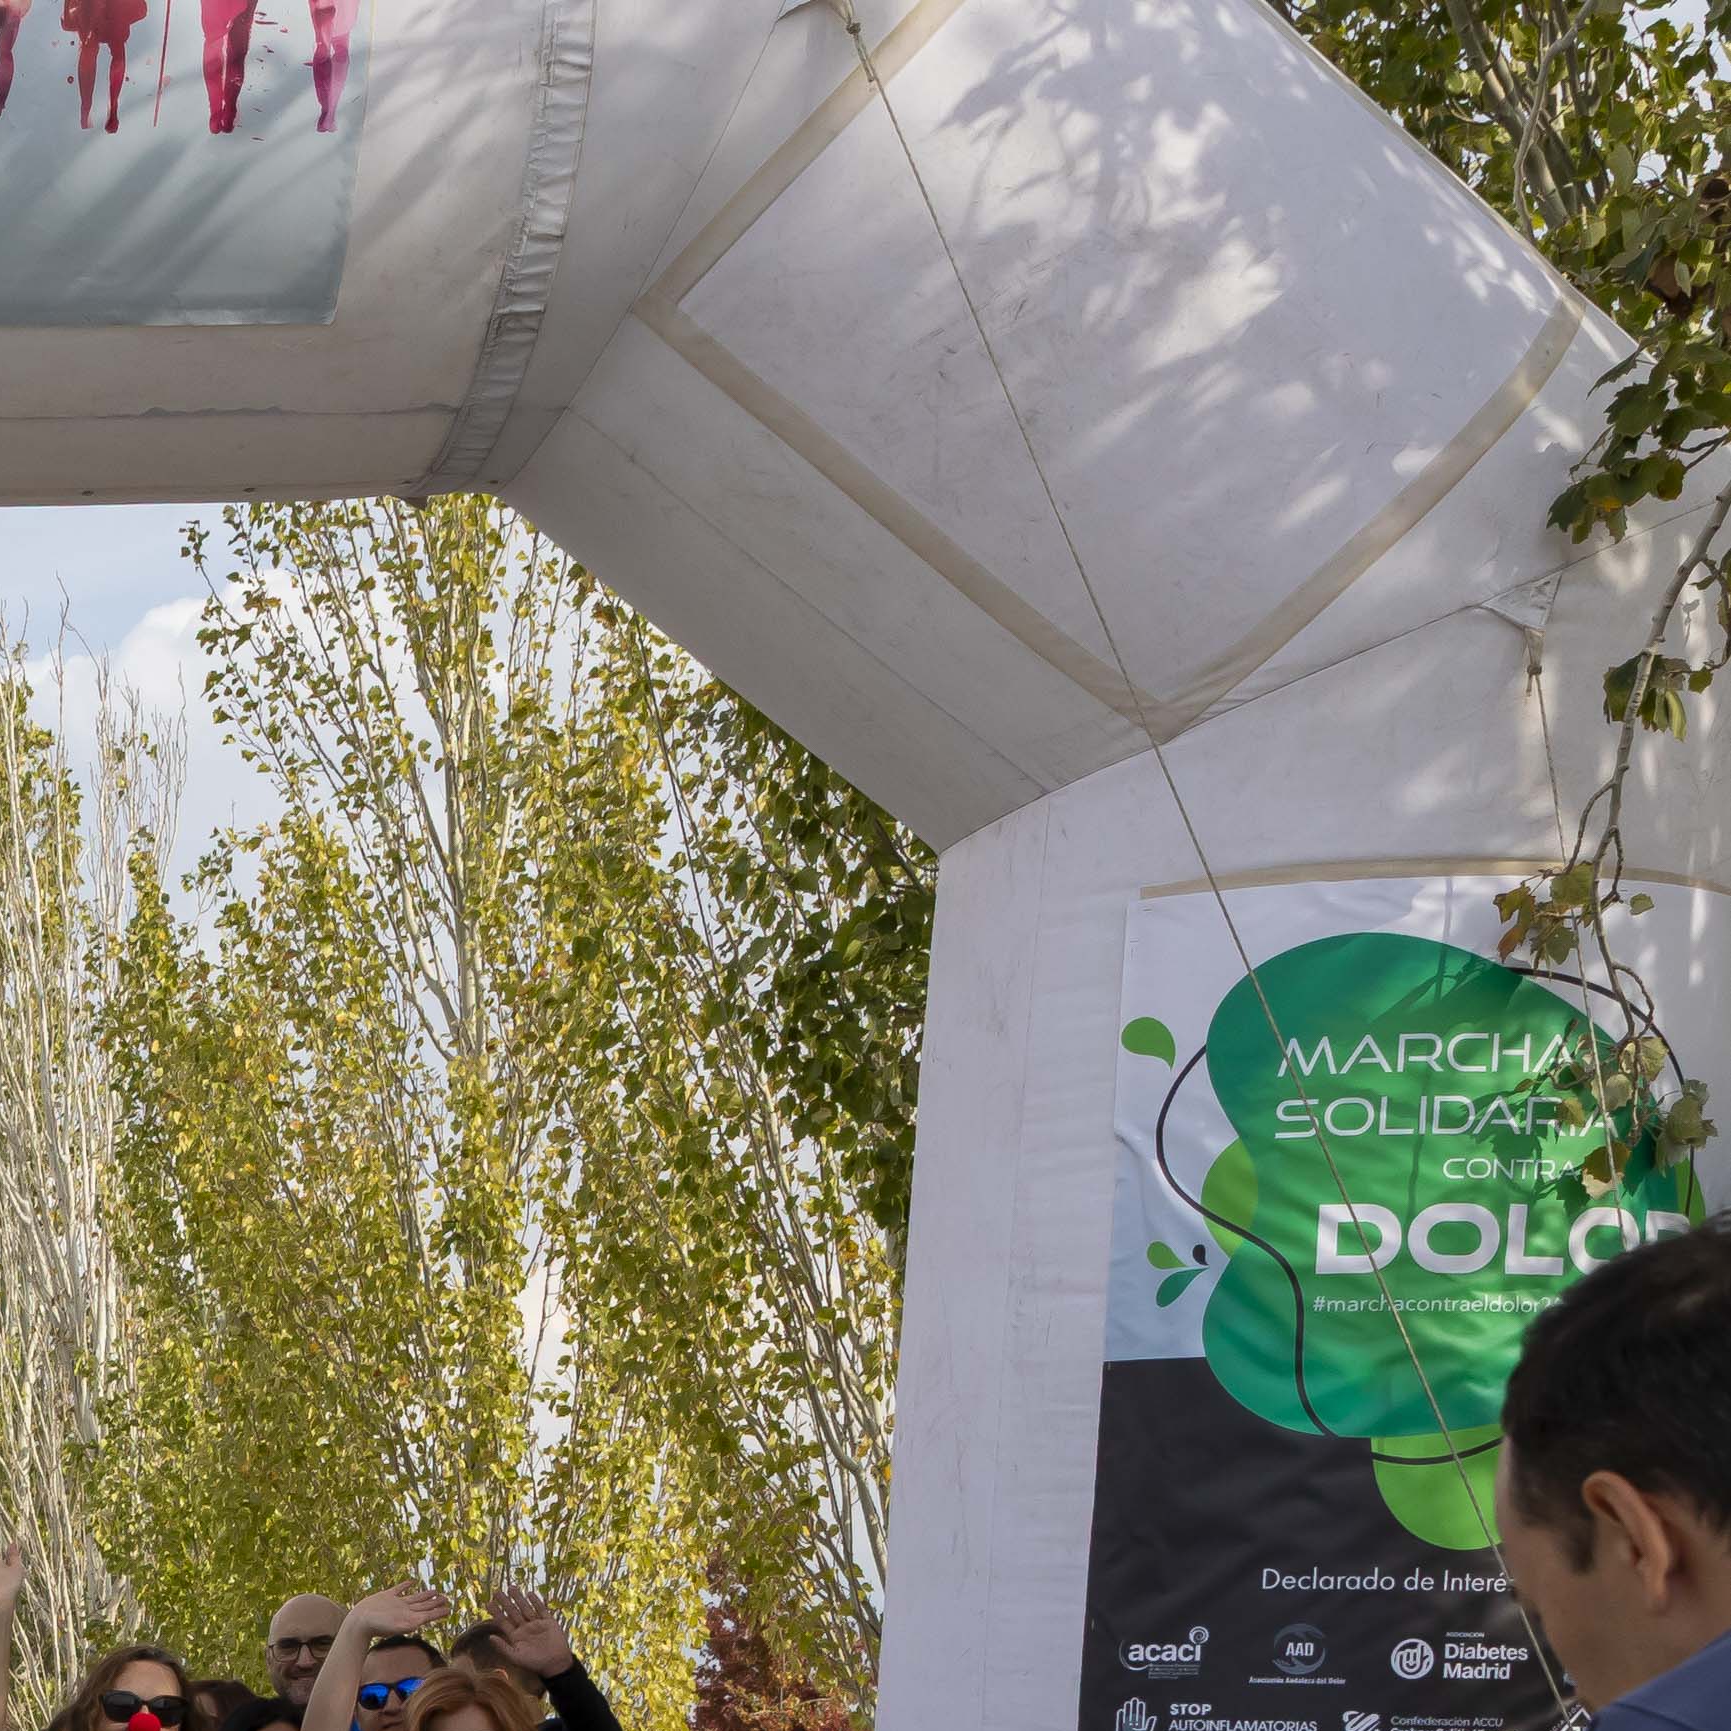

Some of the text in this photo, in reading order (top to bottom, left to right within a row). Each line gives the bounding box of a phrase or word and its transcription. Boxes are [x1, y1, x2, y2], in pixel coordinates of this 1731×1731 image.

[1277, 1033, 1578, 1077] MARCHA
[1442, 1157, 1581, 1181] CONTRA
[1261, 1566, 1510, 1593] Declarado de Interé
[1128, 1636, 1206, 1663] acaci
[1285, 1641, 1315, 1657] AAD
[1444, 1643, 1529, 1661] Diabetes
[1443, 1662, 1511, 1680] Madrid
[1169, 1703, 1212, 1716] STOP
[1390, 1715, 1504, 1727] Confederación ACCU
